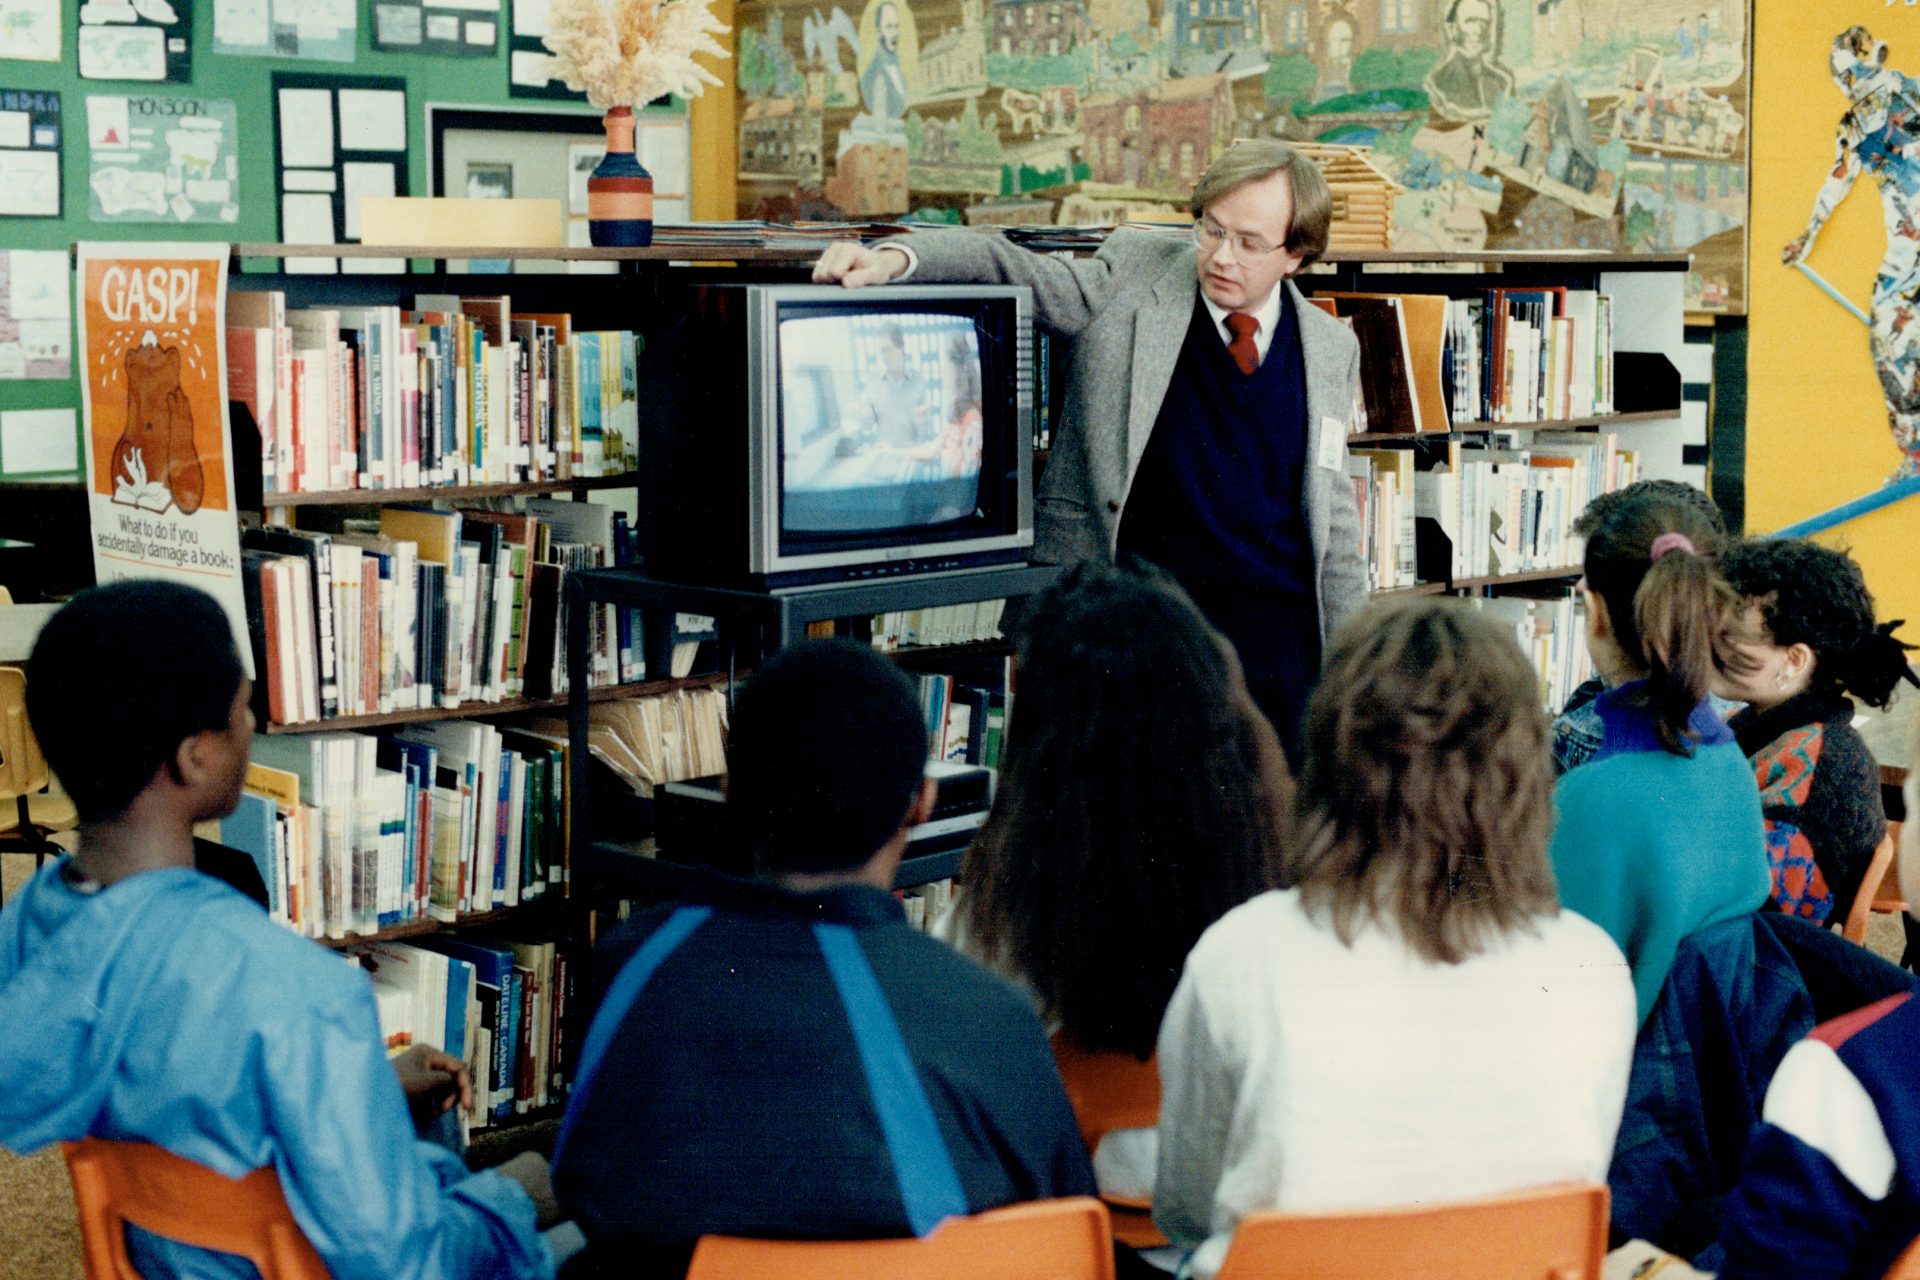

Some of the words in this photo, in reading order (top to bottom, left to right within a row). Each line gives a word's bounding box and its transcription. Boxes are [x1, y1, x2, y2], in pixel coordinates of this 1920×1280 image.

[0, 91, 60, 113] NDRA
[128, 97, 206, 116] MONSOON
[101, 266, 199, 325] GASP!
[118, 514, 142, 536] What
[144, 520, 153, 538] to
[155, 521, 168, 540] do
[169, 523, 177, 541] if
[179, 528, 199, 546] you
[98, 532, 147, 559] accidentally
[147, 540, 189, 567] damage
[190, 551, 198, 563] a
[199, 547, 235, 569] book:
[498, 1036, 508, 1088] CANADA
